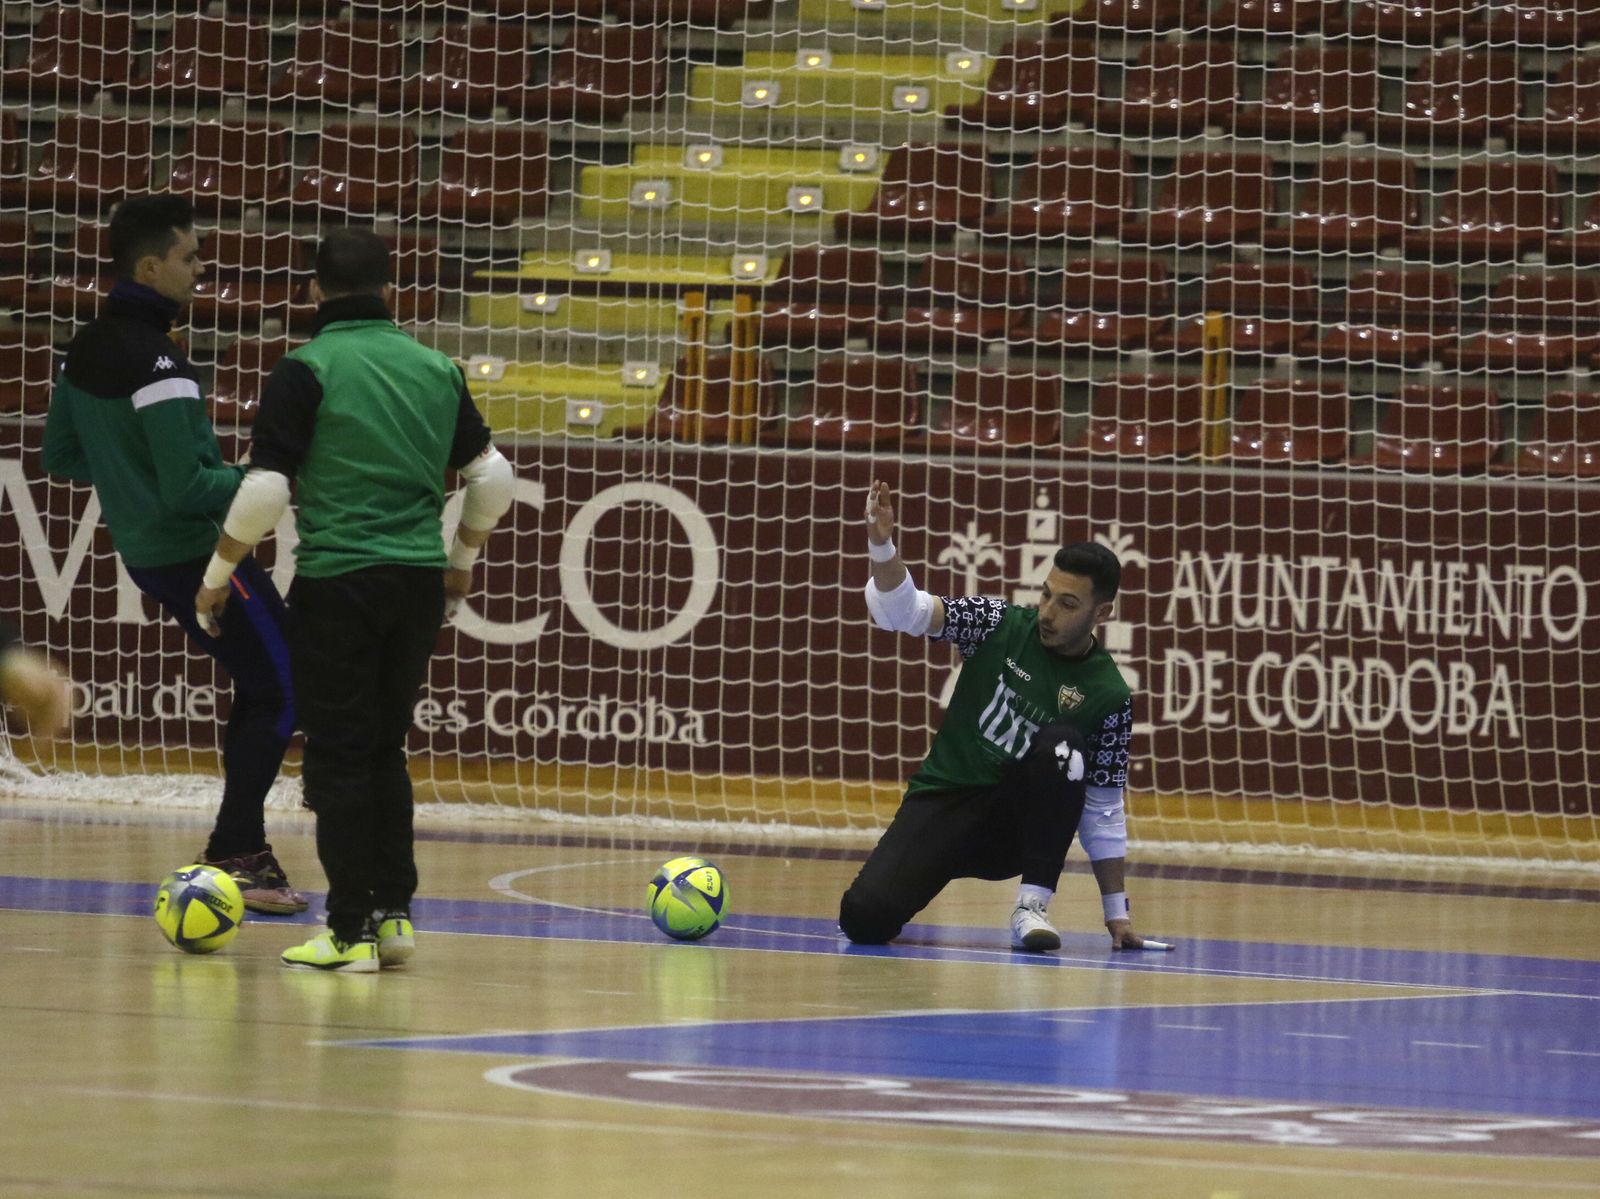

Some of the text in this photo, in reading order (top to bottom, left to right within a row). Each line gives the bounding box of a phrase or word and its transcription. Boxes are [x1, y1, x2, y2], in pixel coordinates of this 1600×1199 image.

[1163, 549, 1588, 643] AYUNTAMIENTO
[152, 673, 216, 721] de
[484, 688, 707, 746] Córdoba
[1162, 642, 1521, 739] DE CÓRDOBA
